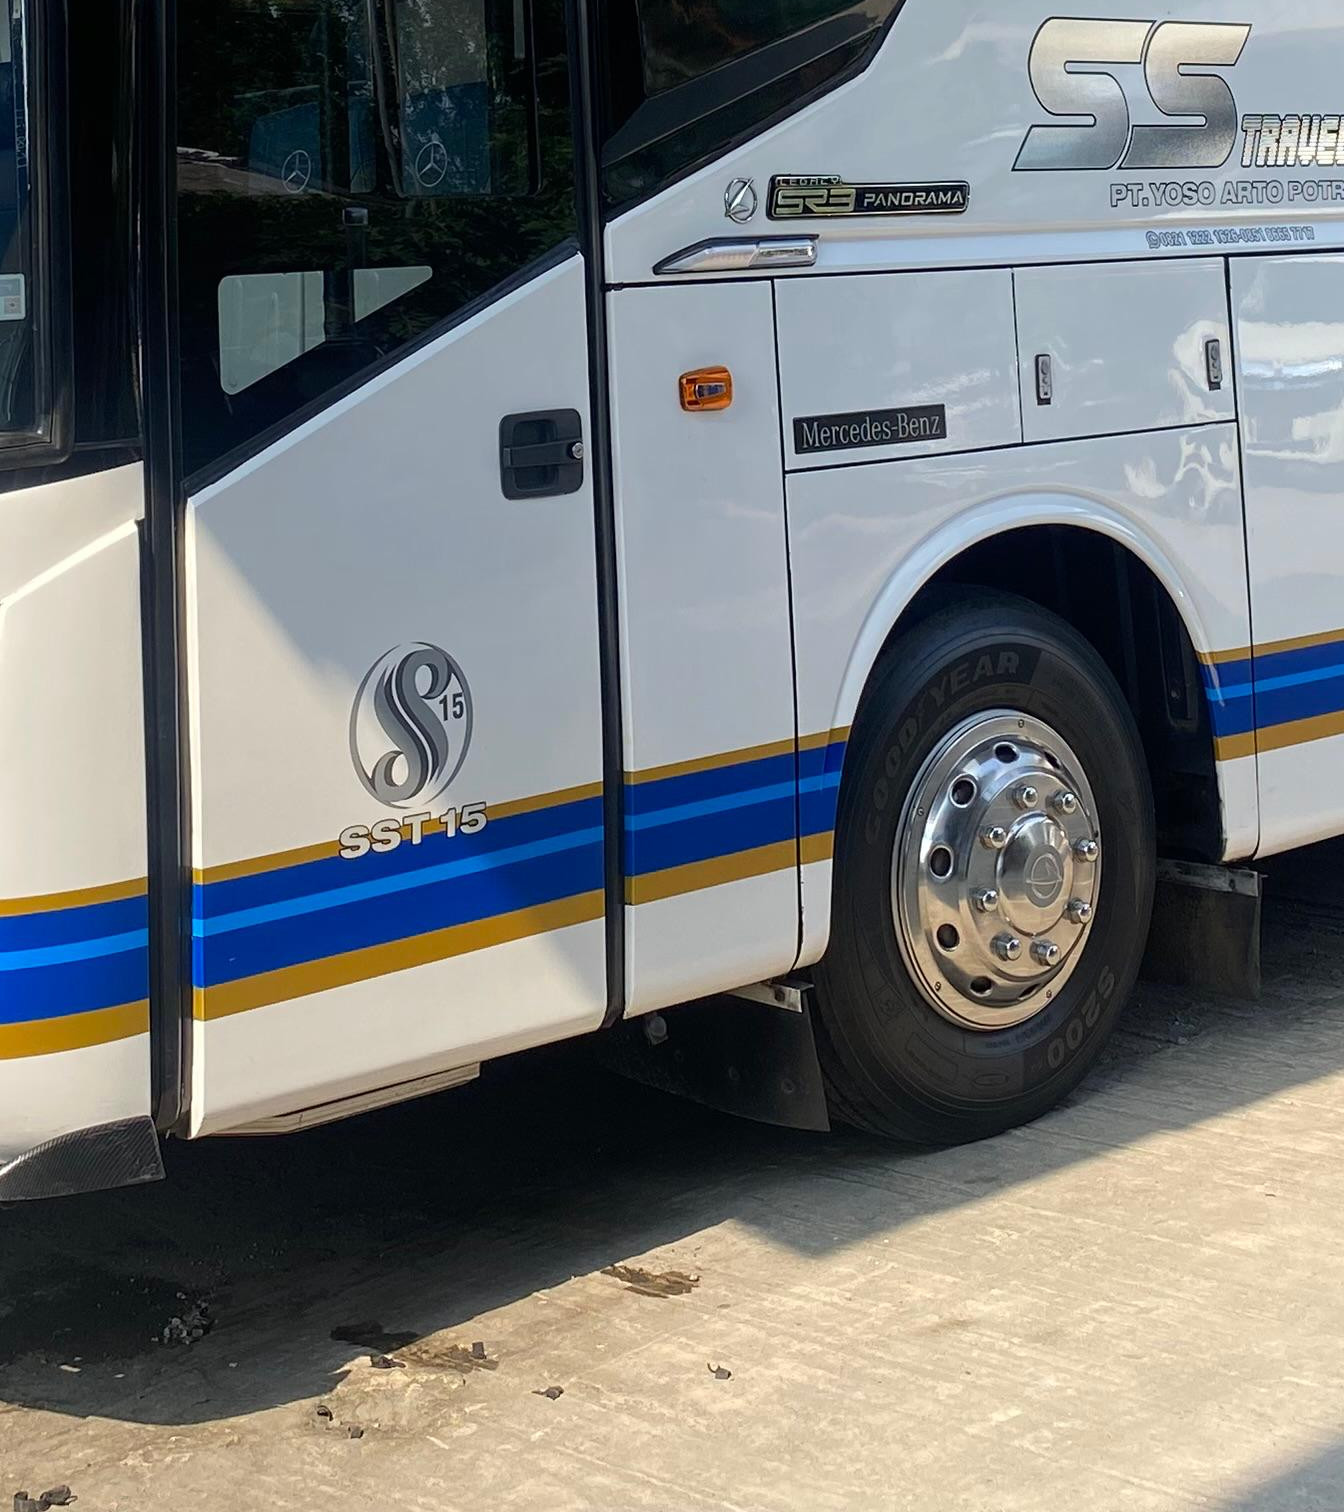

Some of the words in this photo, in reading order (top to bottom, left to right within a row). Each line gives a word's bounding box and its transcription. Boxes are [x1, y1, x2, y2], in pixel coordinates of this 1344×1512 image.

[1012, 16, 1252, 171] SS
[863, 191, 965, 208] PANORAMA
[1220, 180, 1284, 206] ARTO
[1187, 230, 1214, 245] 1222
[801, 413, 941, 449] Mercedes-Benz
[438, 691, 465, 722] 15
[865, 651, 1021, 846] GOODYEAR
[338, 811, 431, 860] SST
[438, 801, 487, 838] 15
